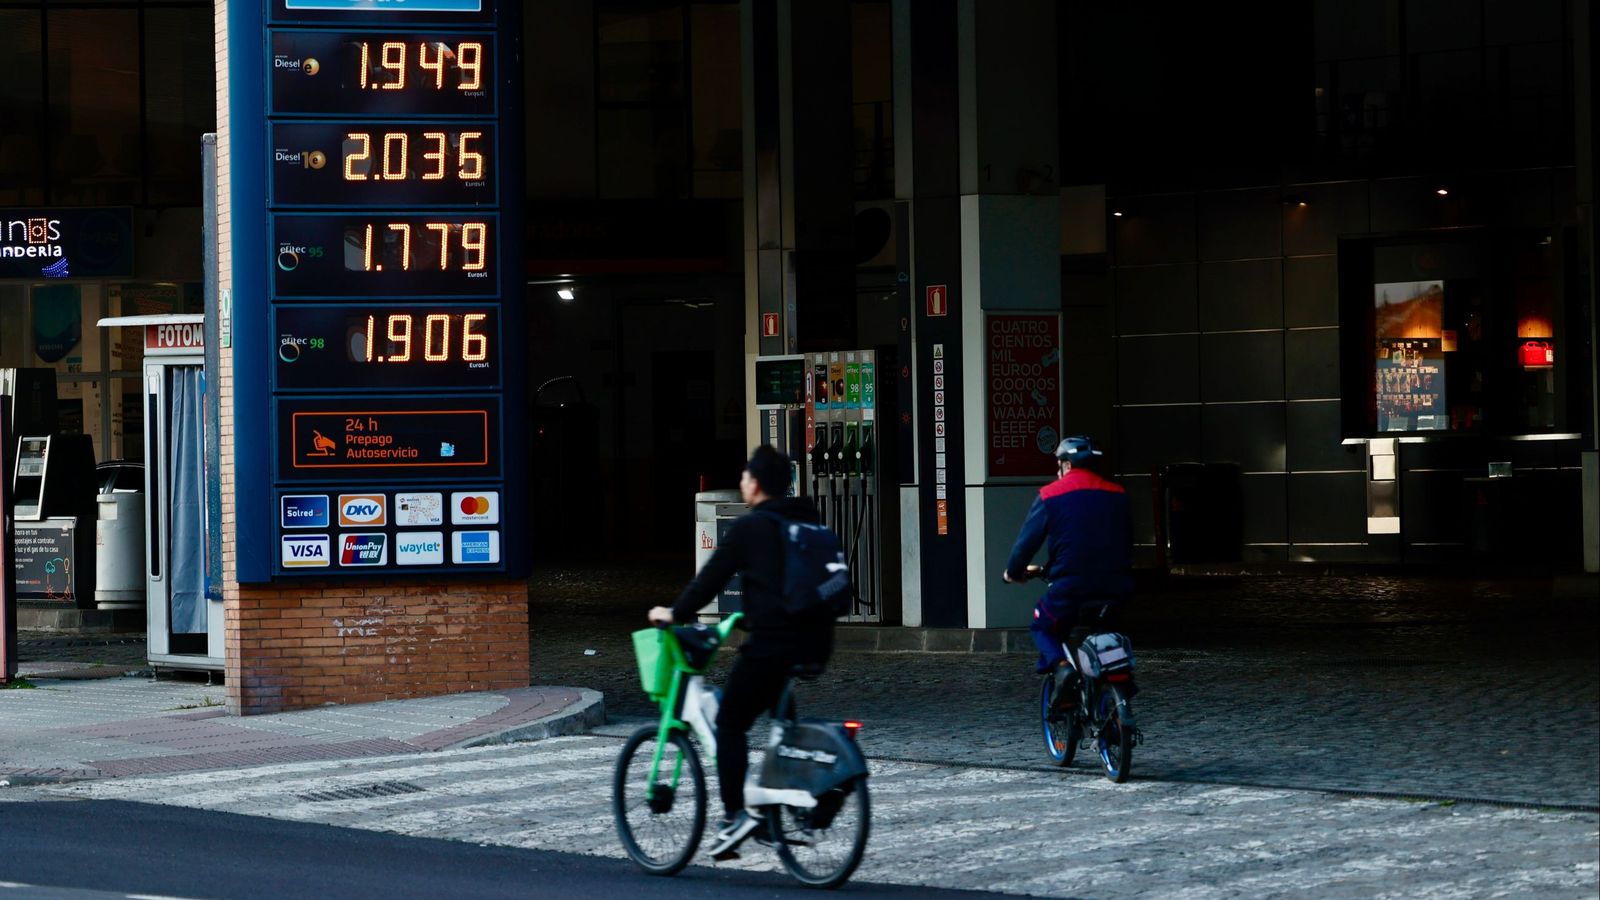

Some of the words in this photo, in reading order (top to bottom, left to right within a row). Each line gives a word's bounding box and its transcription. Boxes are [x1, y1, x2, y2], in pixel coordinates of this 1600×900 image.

[274, 58, 300, 68] Diesel
[360, 42, 482, 90] 1.949
[275, 152, 301, 161] Diesel
[308, 246, 324, 258] 95
[364, 222, 487, 271] 1.779
[991, 320, 1049, 334] CUATRO
[309, 338, 325, 349] 98
[365, 314, 487, 363] 1.906
[991, 335, 1053, 348] CIENTOS
[991, 349, 1016, 362] MIL
[992, 363, 1042, 377] EUROO
[850, 383, 860, 393] 98
[864, 383, 874, 393] 95
[992, 392, 1024, 406] CON
[993, 406, 1055, 420] WAAAAY
[345, 418, 364, 432] 24
[369, 417, 378, 431] h
[993, 420, 1037, 434] LEEEE
[346, 434, 393, 447] Prepago
[993, 435, 1027, 449] EEET
[347, 446, 419, 459] Autoservicio
[287, 509, 314, 517] Solred
[345, 505, 379, 516] DKV
[15, 538, 33, 546] postajes
[345, 541, 382, 551] UnionPay
[399, 542, 438, 555] waylet
[289, 545, 323, 557] VISA
